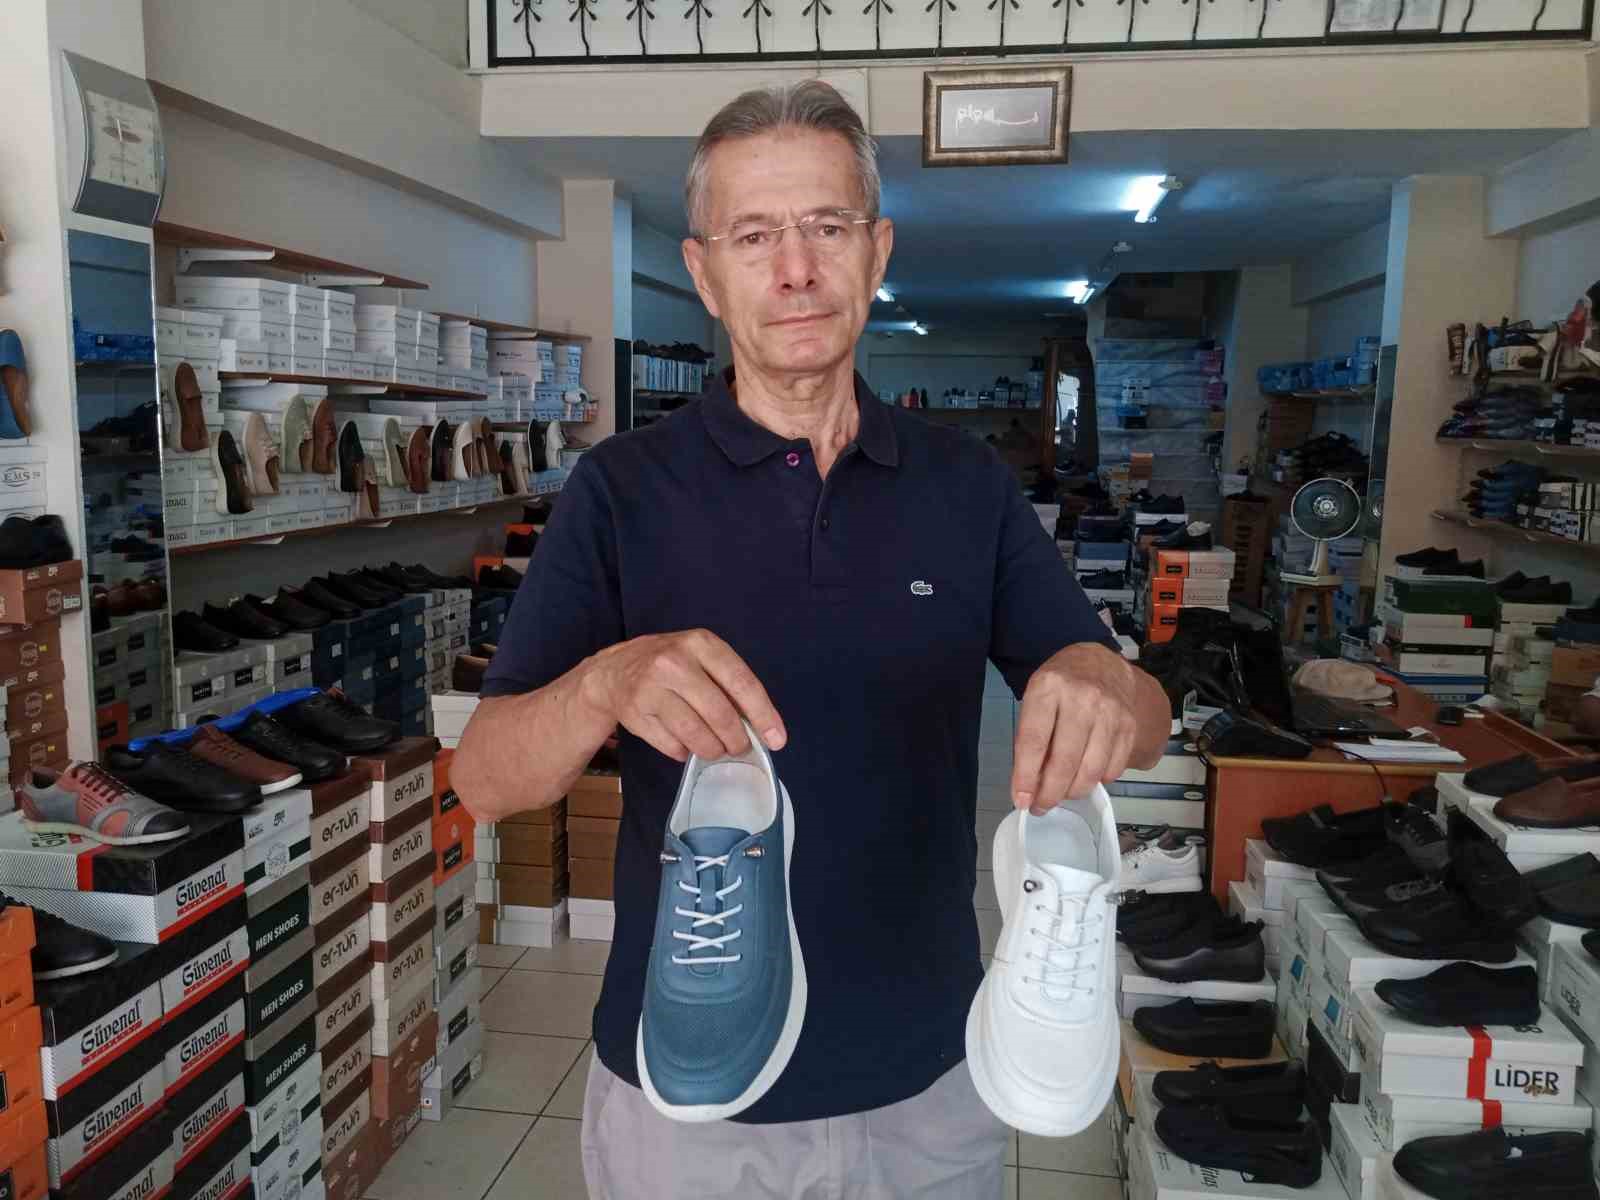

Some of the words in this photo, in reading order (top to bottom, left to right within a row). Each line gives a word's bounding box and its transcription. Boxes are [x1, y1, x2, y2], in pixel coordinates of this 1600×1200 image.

[176, 863, 226, 907] Güvenal
[255, 932, 274, 952] MEN
[274, 913, 300, 939] SHOES
[182, 940, 232, 987] Güvenal
[261, 1001, 278, 1021] MEN
[279, 979, 304, 1006] SHOES
[81, 999, 142, 1054] Güvenal
[180, 1014, 229, 1063] Güvenal
[265, 1068, 282, 1088] MEN
[283, 1043, 307, 1069] SHOES
[1494, 1064, 1560, 1092] LİDER
[83, 1081, 144, 1142] Güvenal
[182, 1089, 229, 1142] Güvenal
